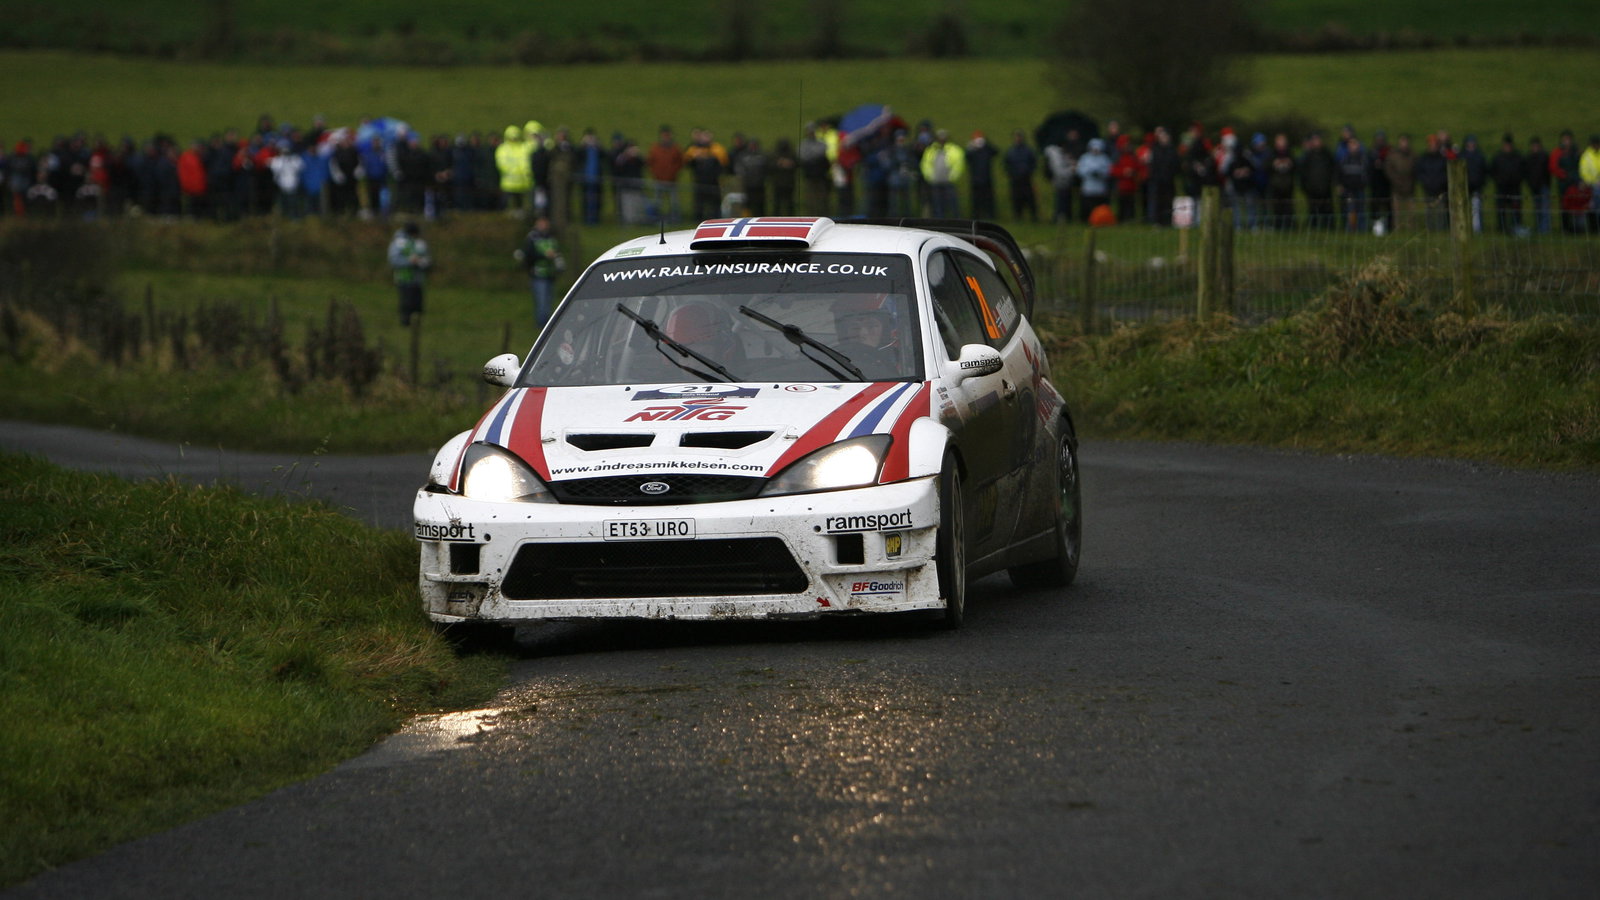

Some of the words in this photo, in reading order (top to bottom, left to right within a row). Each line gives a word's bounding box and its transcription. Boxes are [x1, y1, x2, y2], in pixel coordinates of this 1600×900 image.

[603, 263, 888, 282] WWW.RALLYINSURANCE.CO.UK
[551, 461, 764, 475] www.andreasmikkelsen.com
[826, 508, 912, 531] ramsport
[415, 522, 475, 541] amsport
[610, 522, 648, 537] ET53
[656, 521, 689, 536] URO
[851, 581, 903, 592] BFGoodrich
